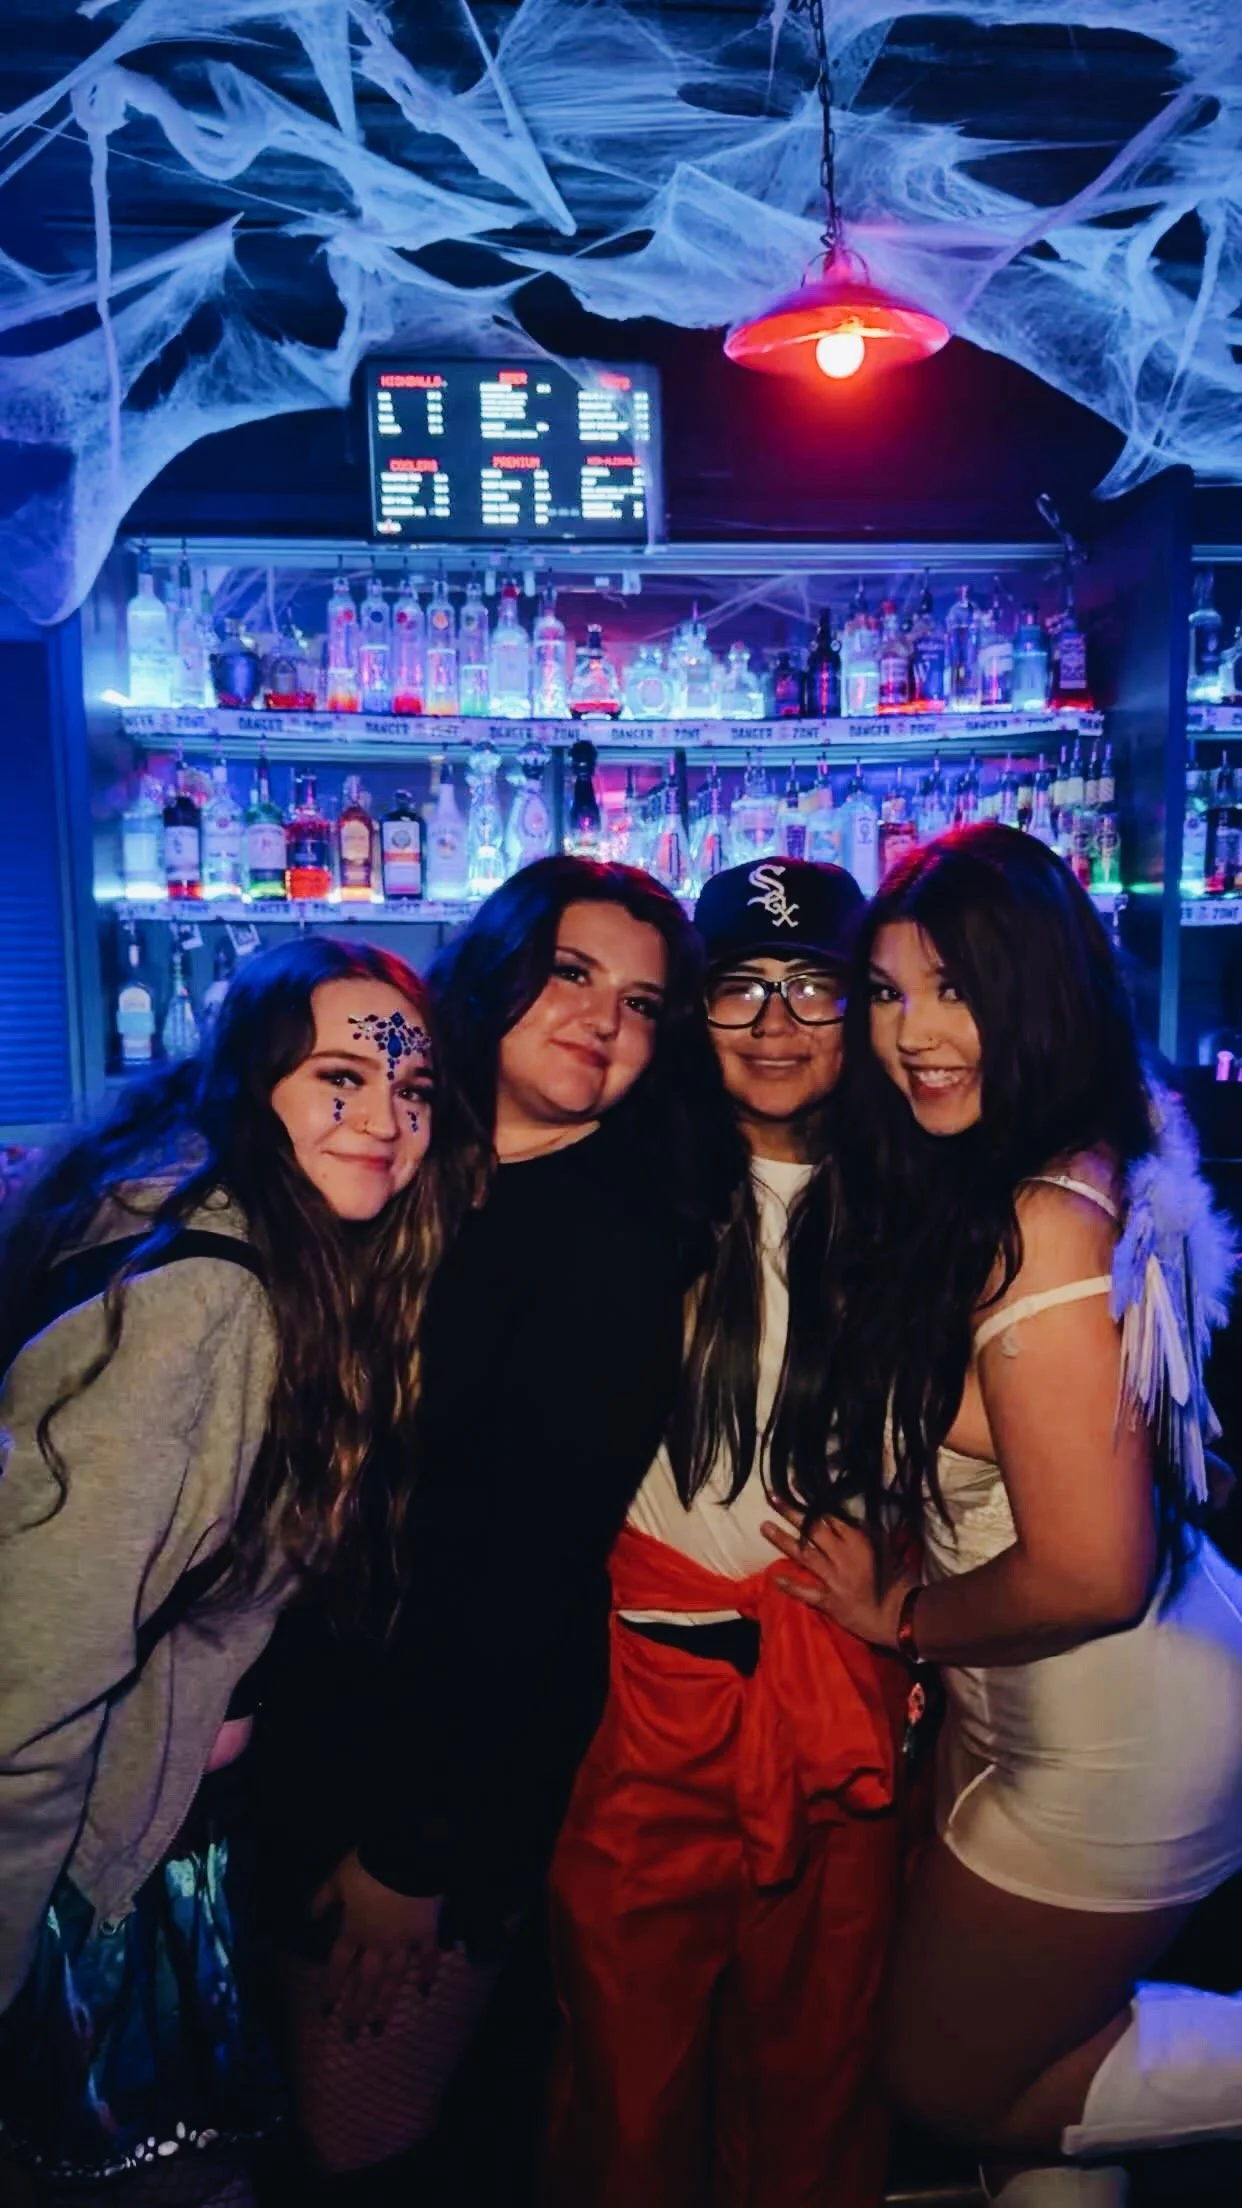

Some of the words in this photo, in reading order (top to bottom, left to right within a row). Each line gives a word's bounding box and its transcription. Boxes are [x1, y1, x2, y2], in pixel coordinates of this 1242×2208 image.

[493, 455, 540, 468] PREMIUM
[552, 726, 581, 740] ZONE
[611, 727, 654, 740] DANGER
[673, 728, 701, 741] ZONE
[731, 727, 773, 739] DANGER
[792, 727, 820, 739] ZONE
[849, 724, 890, 737] DANGER
